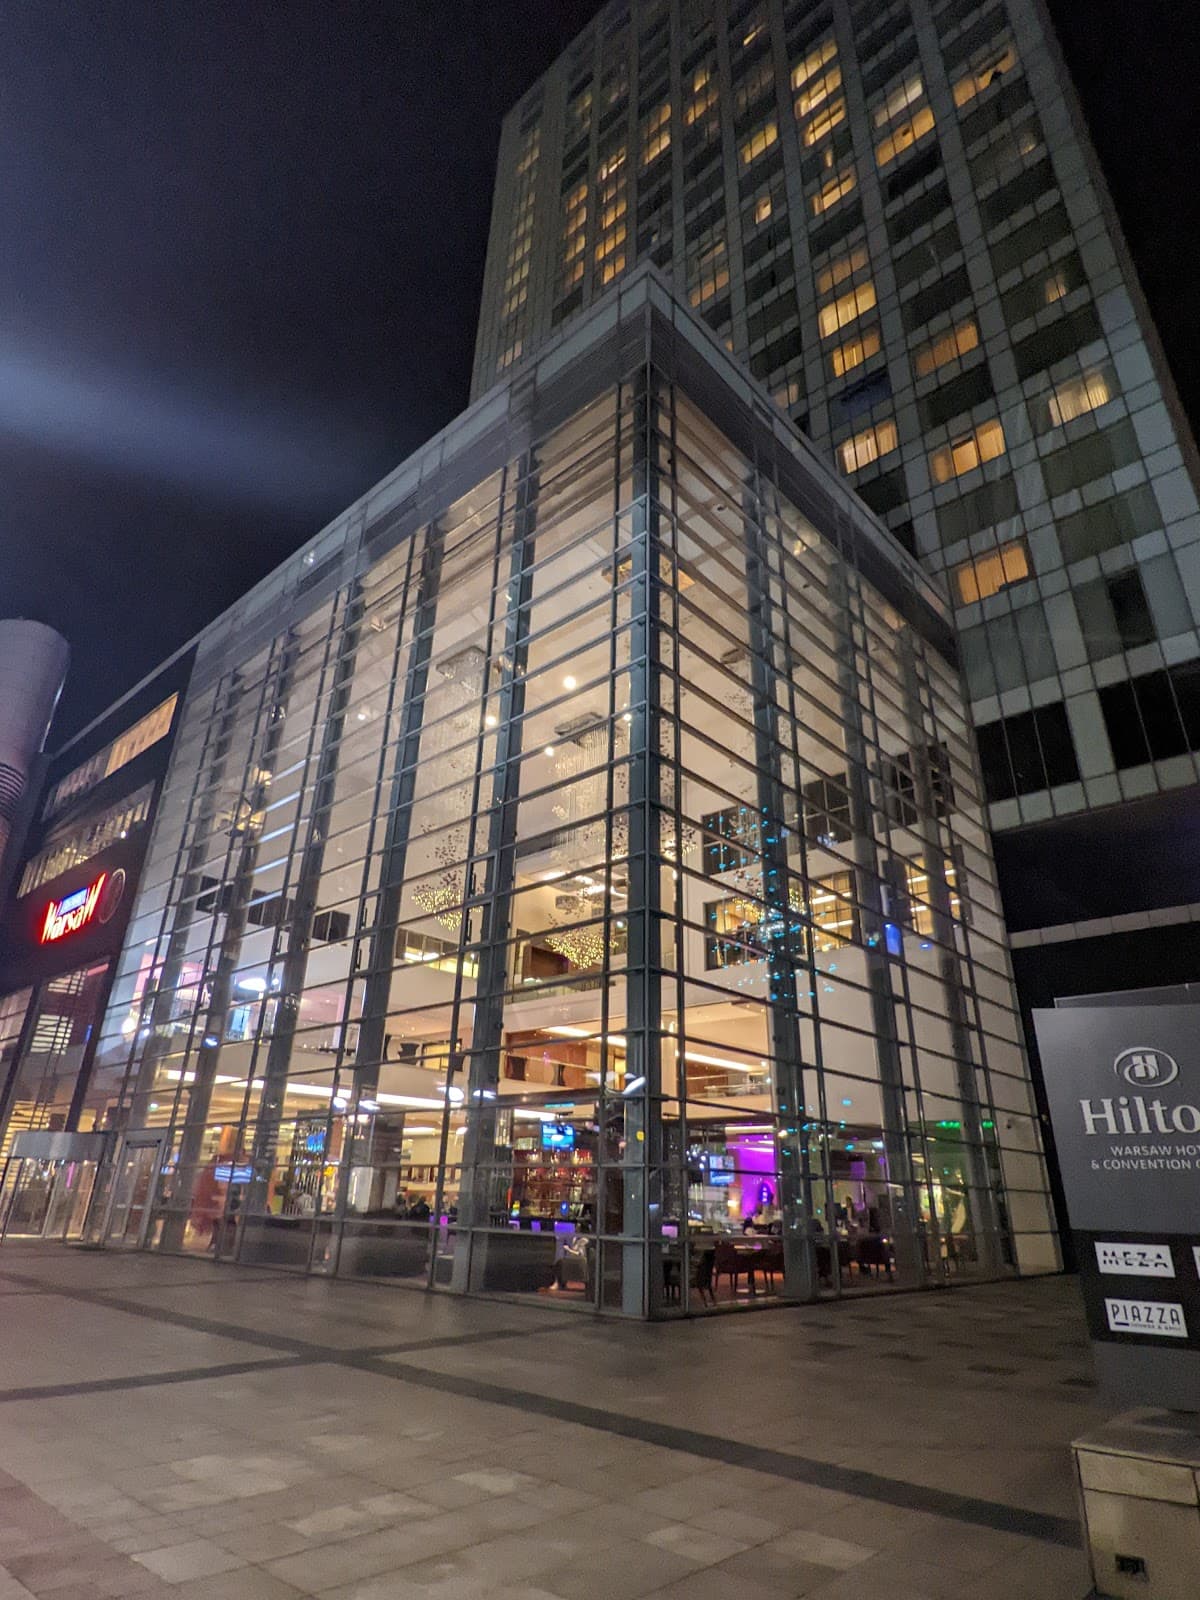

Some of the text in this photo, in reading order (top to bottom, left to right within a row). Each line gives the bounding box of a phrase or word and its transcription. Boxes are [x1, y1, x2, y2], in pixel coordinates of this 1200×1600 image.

[1080, 1096, 1200, 1135] Hilto
[1110, 1144, 1172, 1156] WARSAW
[1091, 1159, 1100, 1170] &
[1103, 1159, 1191, 1170] CONVENTION
[1103, 1250, 1168, 1269] MEZA
[1111, 1304, 1181, 1325] PIAZZA
